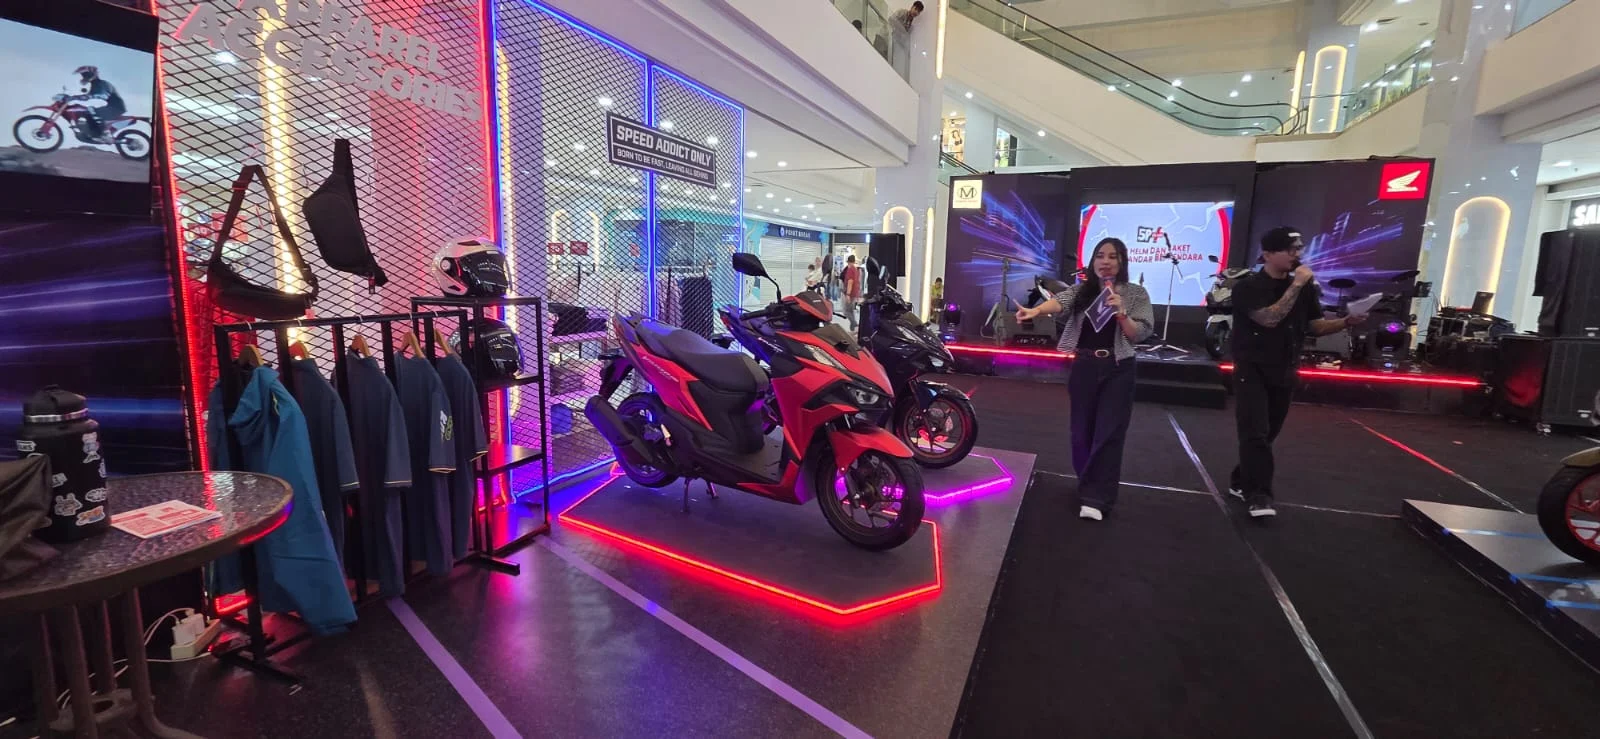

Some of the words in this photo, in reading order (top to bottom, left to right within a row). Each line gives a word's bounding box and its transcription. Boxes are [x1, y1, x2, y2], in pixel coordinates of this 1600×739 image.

[174, 2, 481, 121] ACCESSORIES
[616, 125, 654, 149] SPEED
[655, 138, 690, 160] ADDICT
[690, 149, 712, 167] ONLY
[617, 148, 634, 160] BORN
[635, 153, 643, 162] TO
[643, 155, 651, 164] BE
[651, 157, 666, 169] FAST,
[665, 160, 684, 174] LEAVING
[1573, 204, 1600, 226] SA
[1128, 255, 1153, 263] ANDAR
[1154, 253, 1203, 262] BEENDARA
[1130, 247, 1149, 255] HELM
[1149, 246, 1167, 255] DAN
[1171, 244, 1191, 252] AKET
